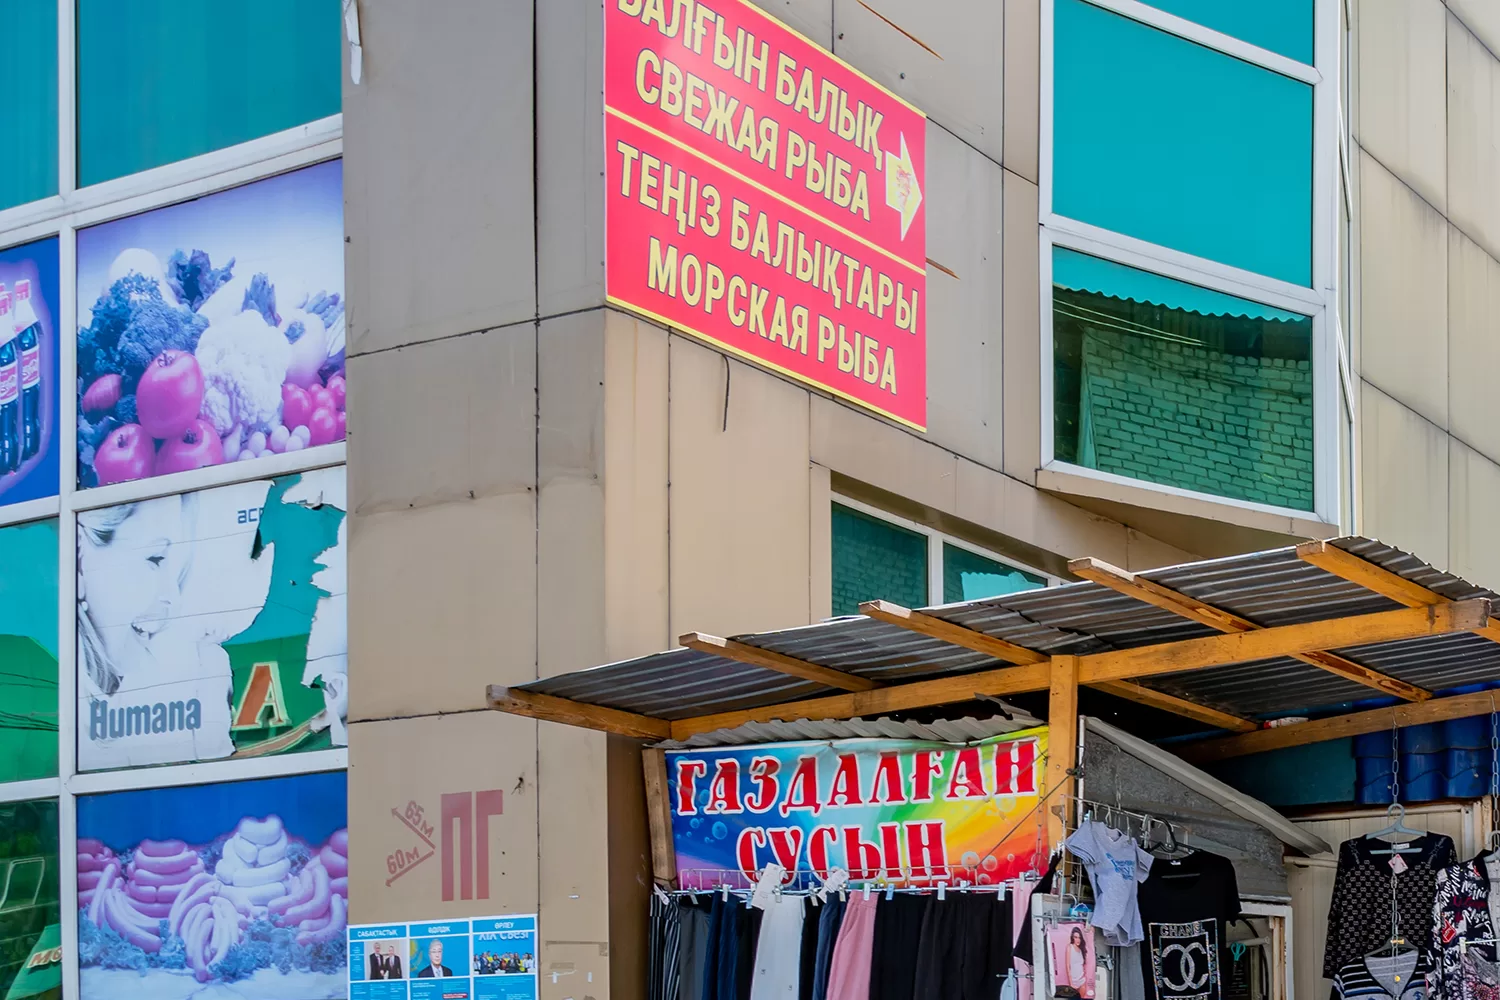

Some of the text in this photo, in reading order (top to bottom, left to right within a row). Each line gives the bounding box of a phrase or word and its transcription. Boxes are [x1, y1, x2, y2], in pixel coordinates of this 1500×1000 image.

[635, 47, 871, 222] СВЕЖАЯ РЫБА
[774, 50, 885, 172] БАЛЫҚ
[616, 139, 919, 335] ТЕҢІЗ БАЛЫҚТАРЫ
[647, 235, 898, 396] МОРСКАЯ РЫБА
[89, 698, 202, 741] Humana
[676, 737, 1041, 817] ГАЗДАЛҒАН
[440, 789, 504, 902] ПГ
[736, 818, 952, 887] СУСЫН
[1159, 921, 1206, 937] CHANEL
